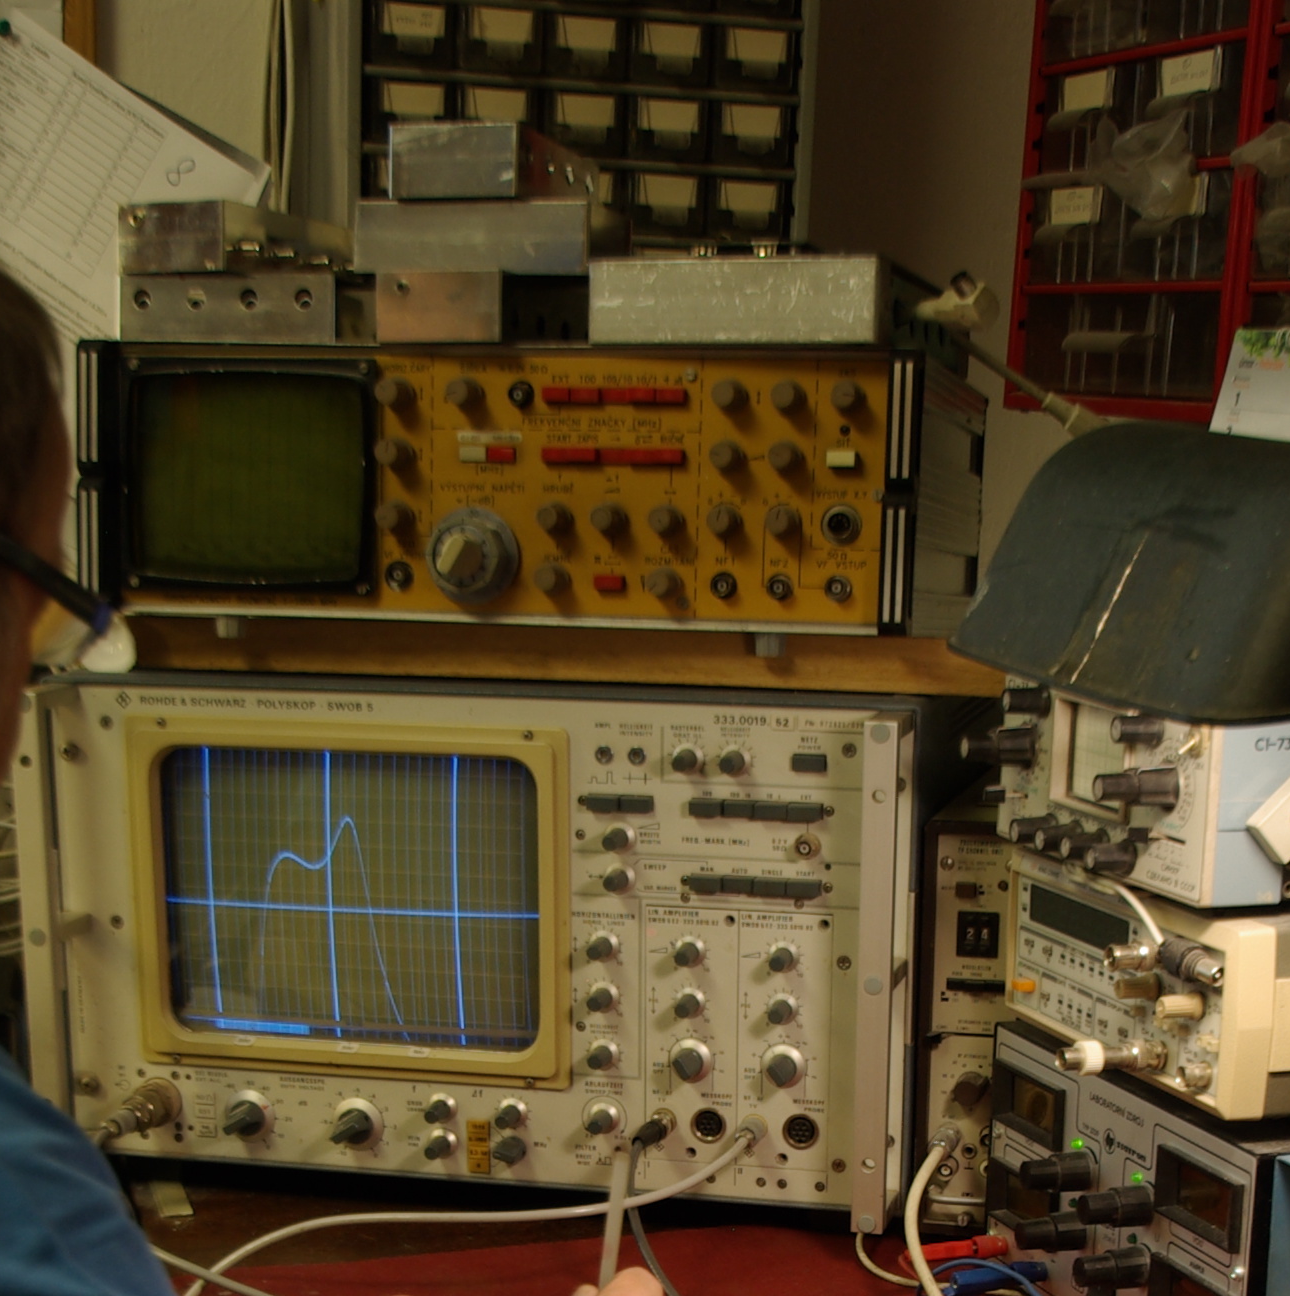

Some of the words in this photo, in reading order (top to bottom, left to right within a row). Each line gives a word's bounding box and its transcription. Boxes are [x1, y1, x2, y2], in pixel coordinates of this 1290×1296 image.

[139, 695, 178, 707] ROHDE
[180, 697, 188, 707] &
[190, 697, 248, 709] SCHWARZ
[256, 699, 316, 711] POLYSKOP
[327, 701, 363, 713] SWOB
[367, 702, 374, 713] 5
[663, 909, 700, 918] AMPLIFIER
